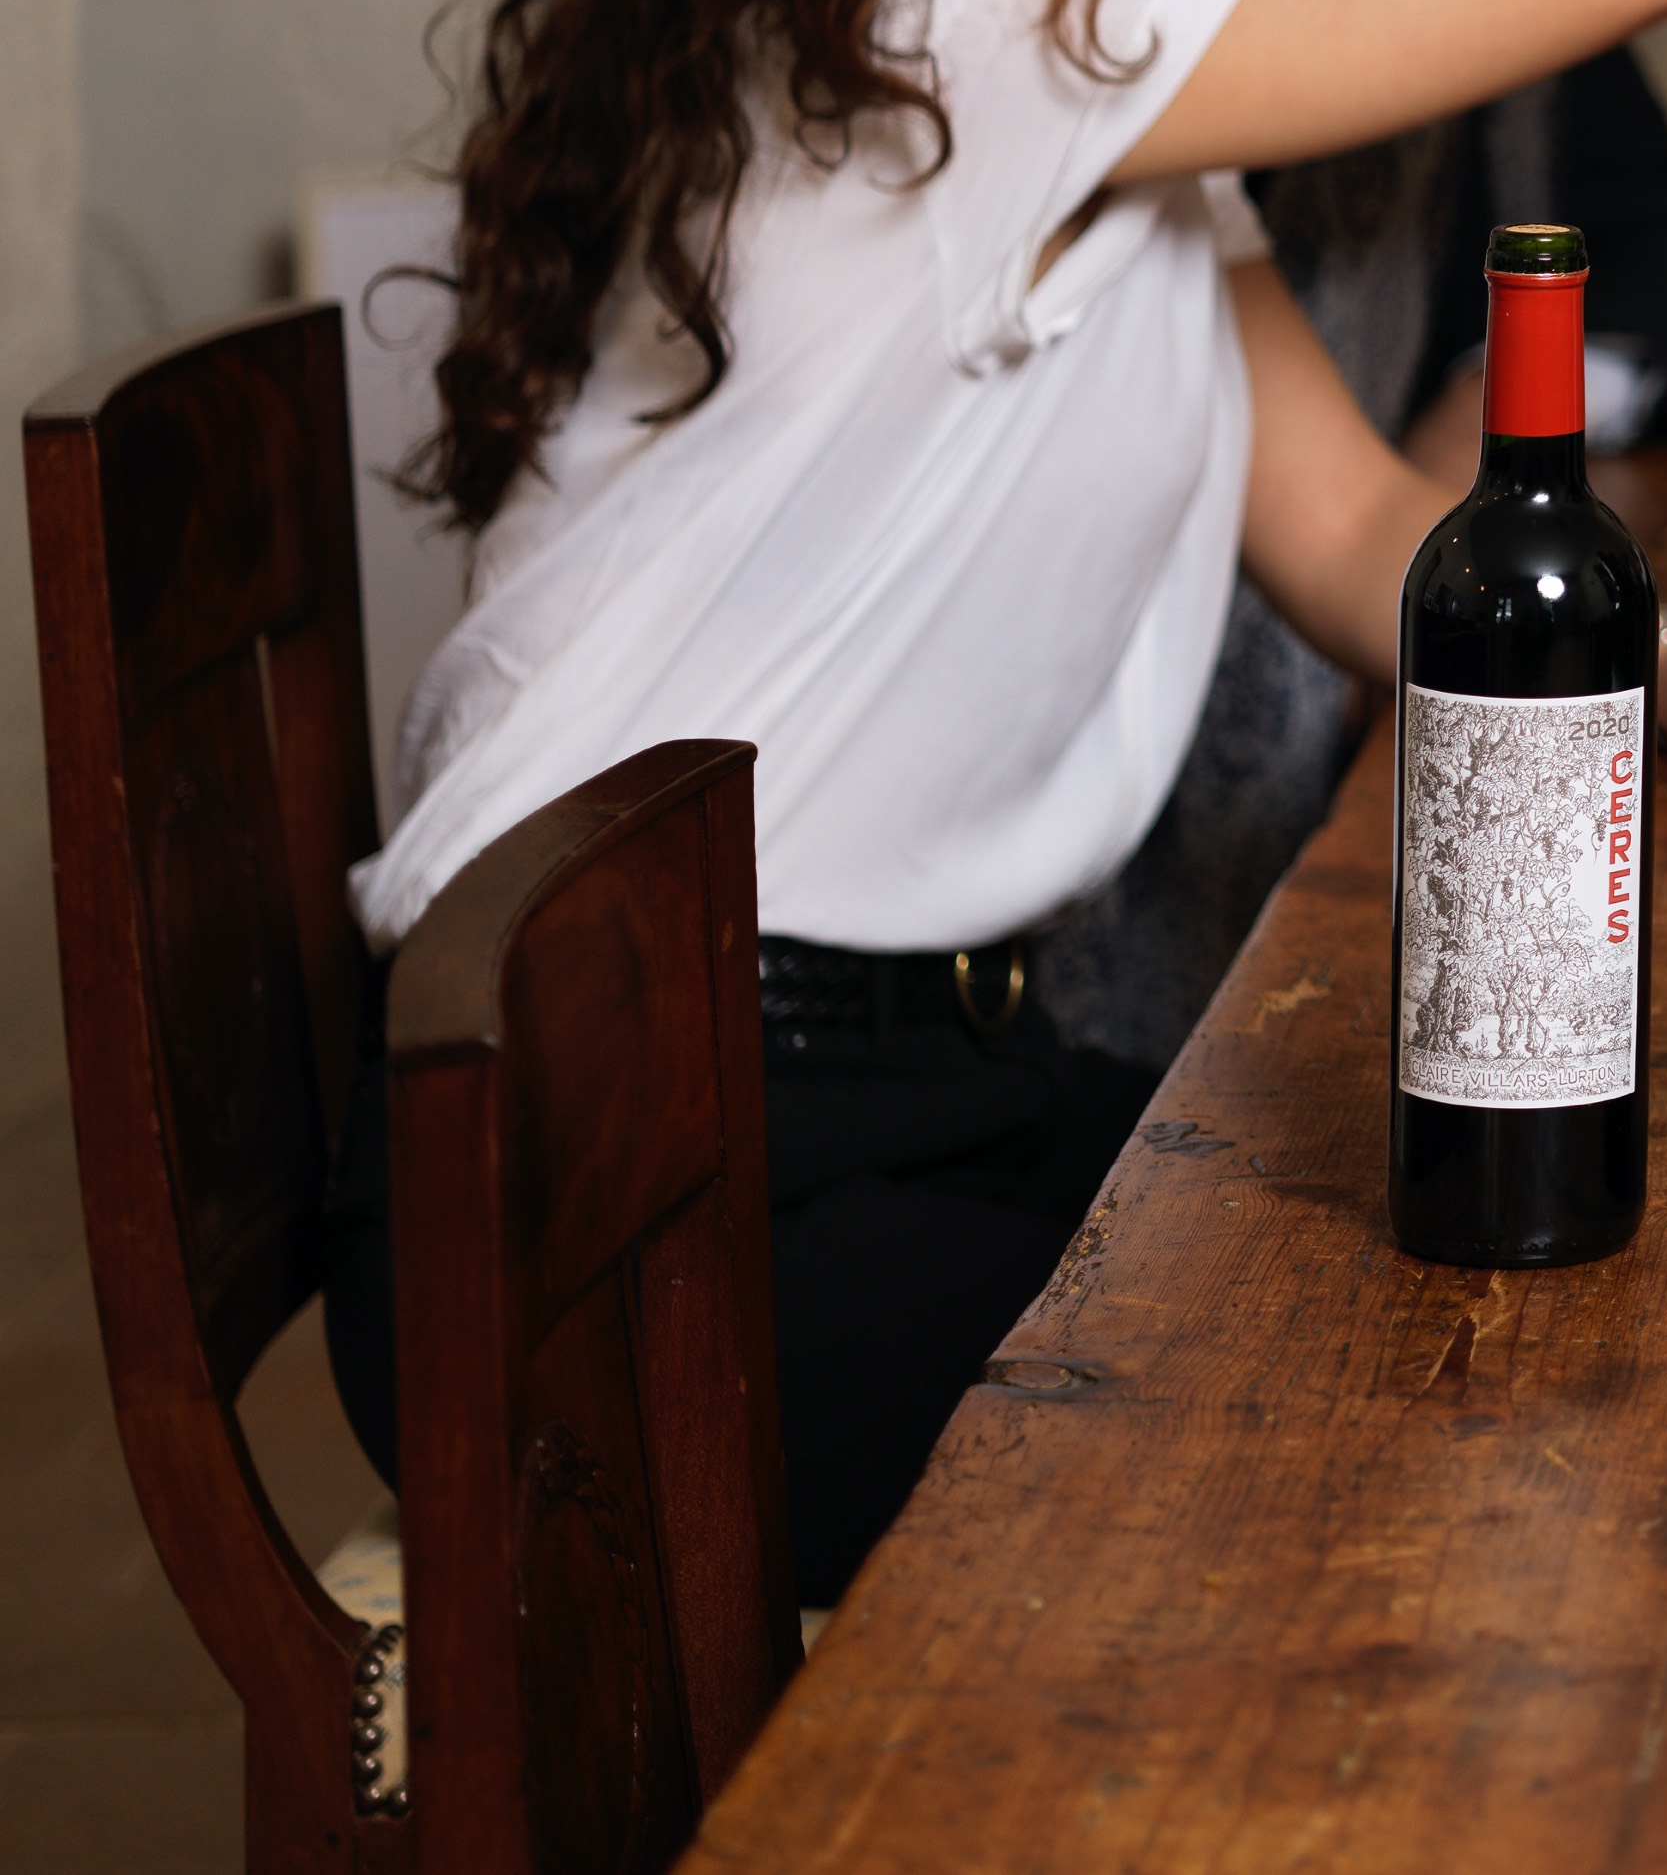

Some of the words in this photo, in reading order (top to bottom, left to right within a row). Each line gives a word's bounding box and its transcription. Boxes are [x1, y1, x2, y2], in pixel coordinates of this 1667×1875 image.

[1568, 714, 1630, 740] 2020
[1607, 750, 1634, 945] CERES
[1411, 1060, 1461, 1084] CLAIRE
[1468, 1063, 1617, 1088] VILLARS-LURTON
